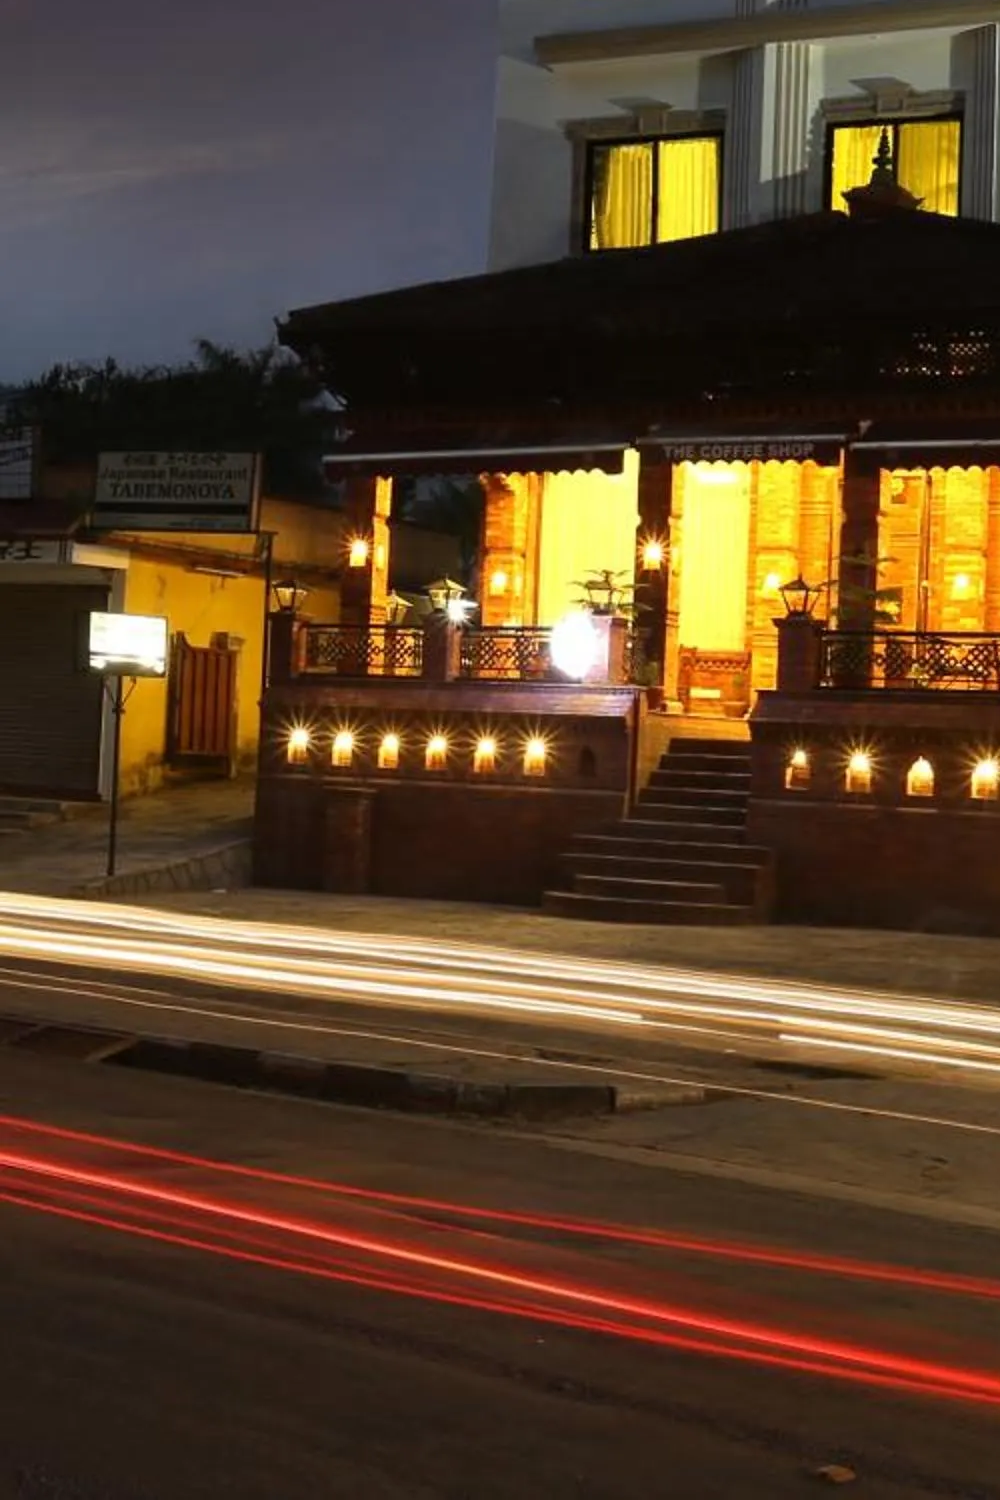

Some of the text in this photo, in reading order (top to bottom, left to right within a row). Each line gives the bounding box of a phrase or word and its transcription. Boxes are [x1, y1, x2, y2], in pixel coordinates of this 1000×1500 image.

[663, 443, 814, 458] THE COFFEE SHOP
[169, 466, 248, 480] Restaurant
[109, 482, 235, 500] TABEMONOYA
